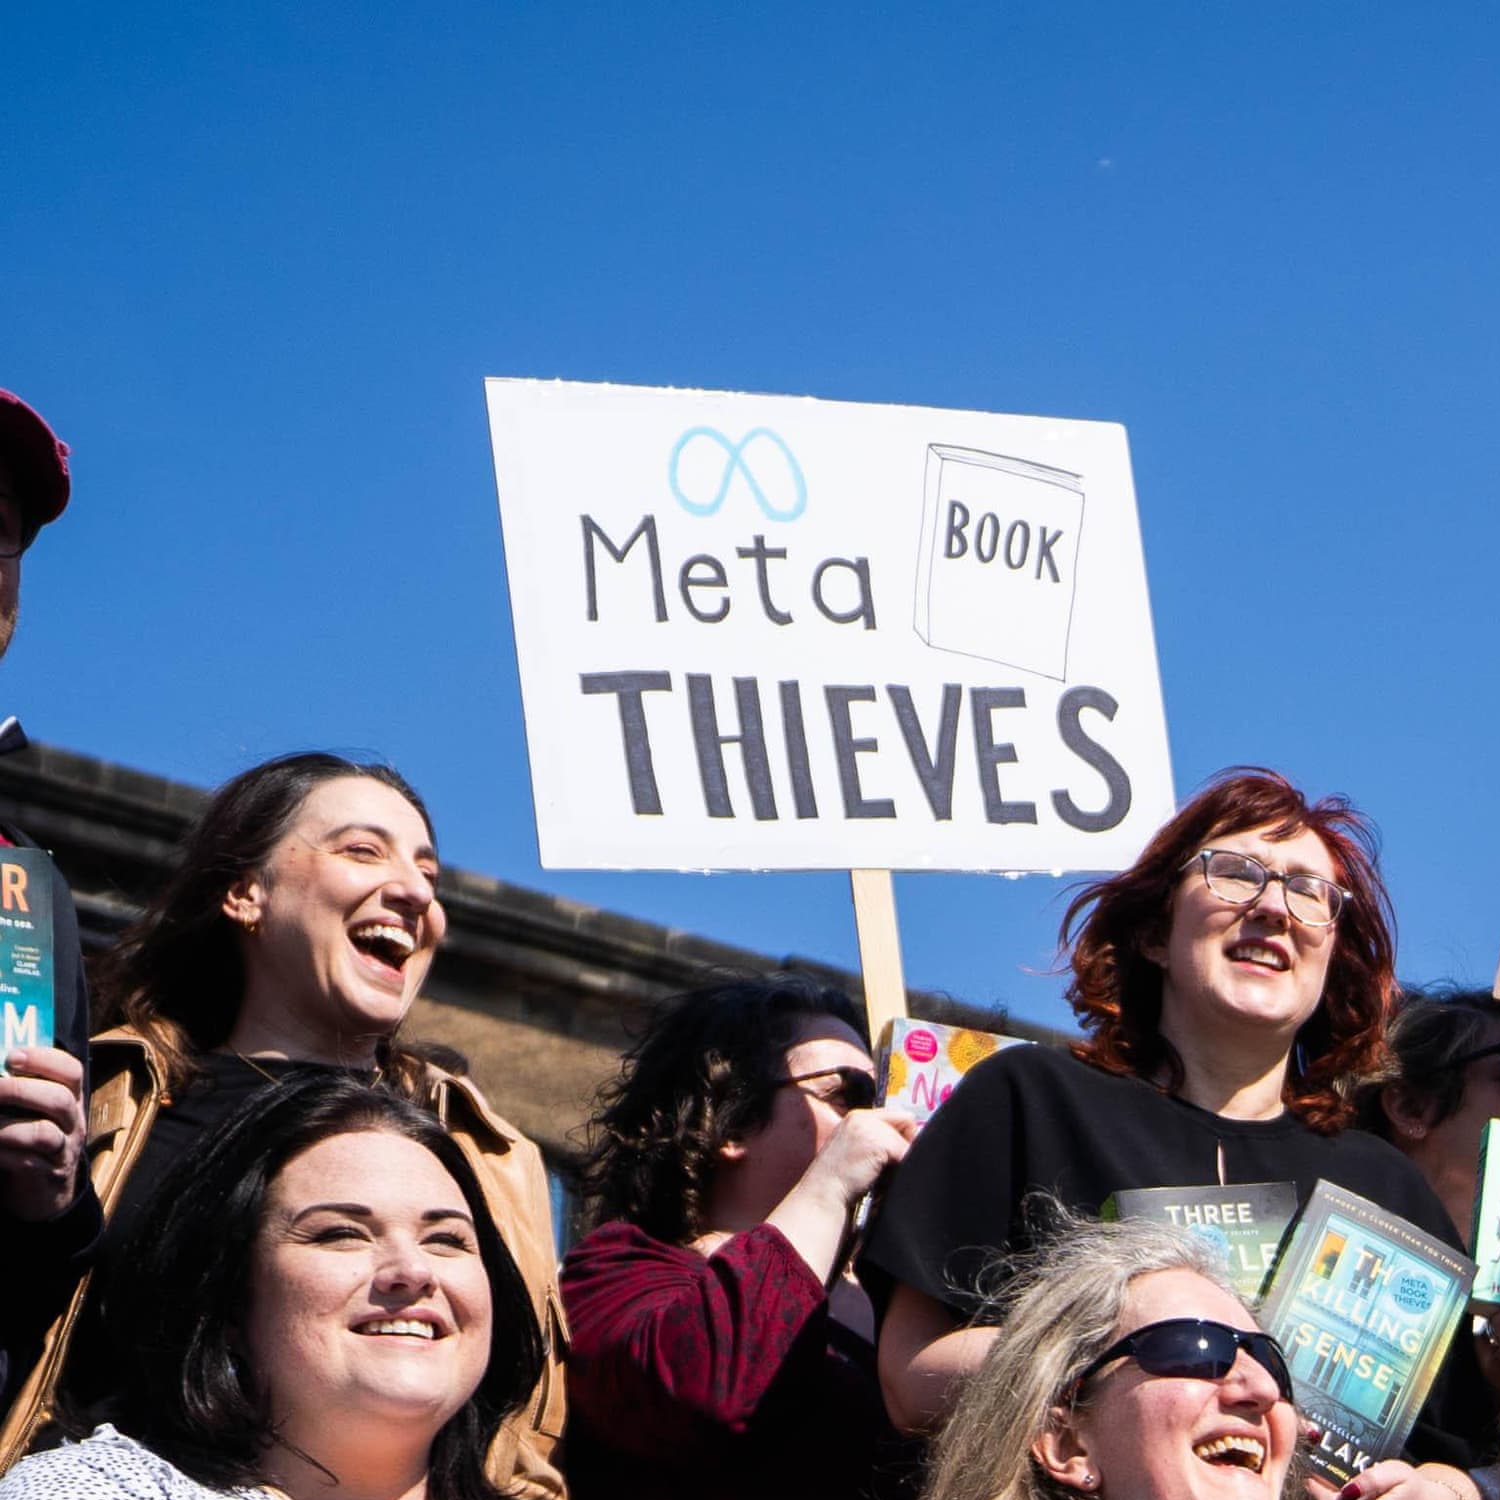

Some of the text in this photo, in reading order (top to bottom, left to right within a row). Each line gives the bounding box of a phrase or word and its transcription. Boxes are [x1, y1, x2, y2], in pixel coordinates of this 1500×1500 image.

[580, 514, 878, 630] Meta
[943, 499, 1064, 584] BOOK
[579, 669, 1132, 834] THIEVES
[1163, 1202, 1254, 1226] THREE
[1354, 1246, 1394, 1286] TH
[1400, 1285, 1428, 1300] BOOK
[1402, 1276, 1428, 1290] META
[1303, 1278, 1425, 1354] KILLING
[1295, 1322, 1394, 1391] SENSE
